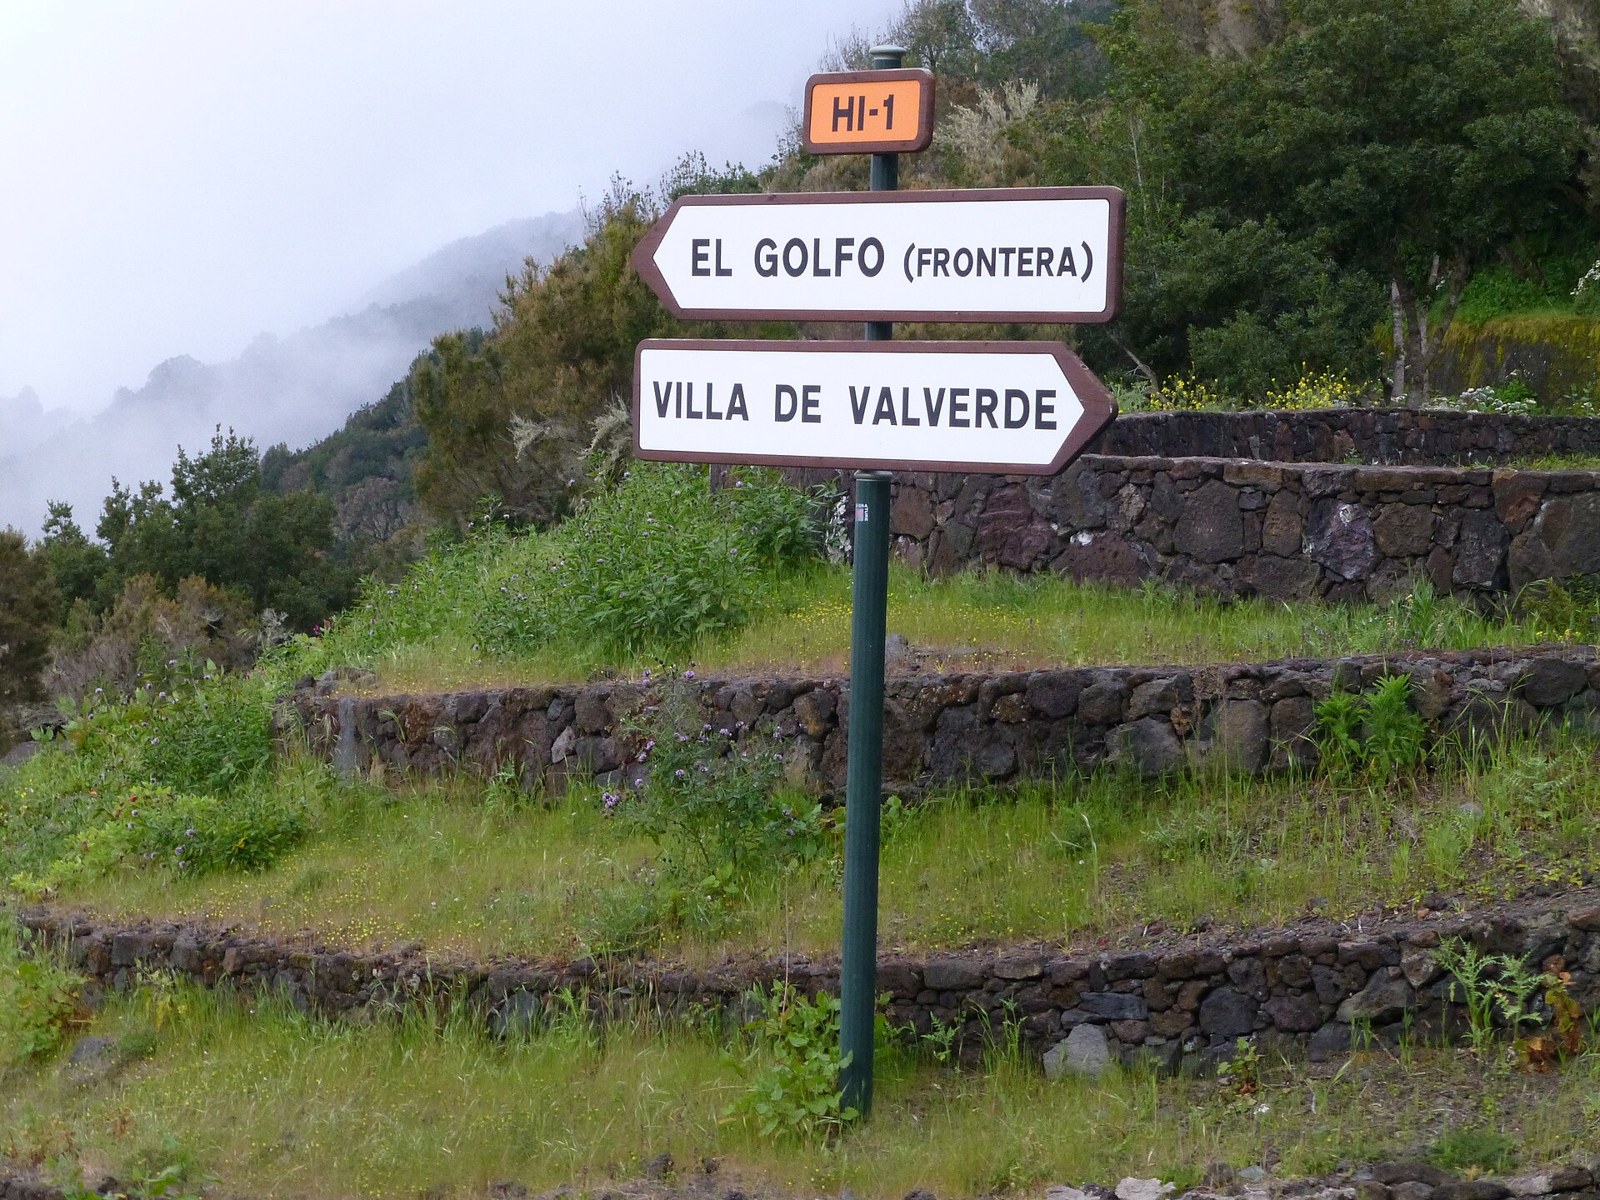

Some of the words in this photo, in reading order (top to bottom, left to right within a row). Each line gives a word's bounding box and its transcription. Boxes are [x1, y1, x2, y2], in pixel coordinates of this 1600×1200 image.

[832, 95, 895, 132] HI-1
[691, 239, 732, 276] EL
[754, 237, 885, 278] GOLFO
[903, 241, 1093, 283] (FRONTERA)
[653, 381, 749, 421] VILLA
[774, 385, 822, 423] DE
[849, 386, 1057, 430] VALVERDE
